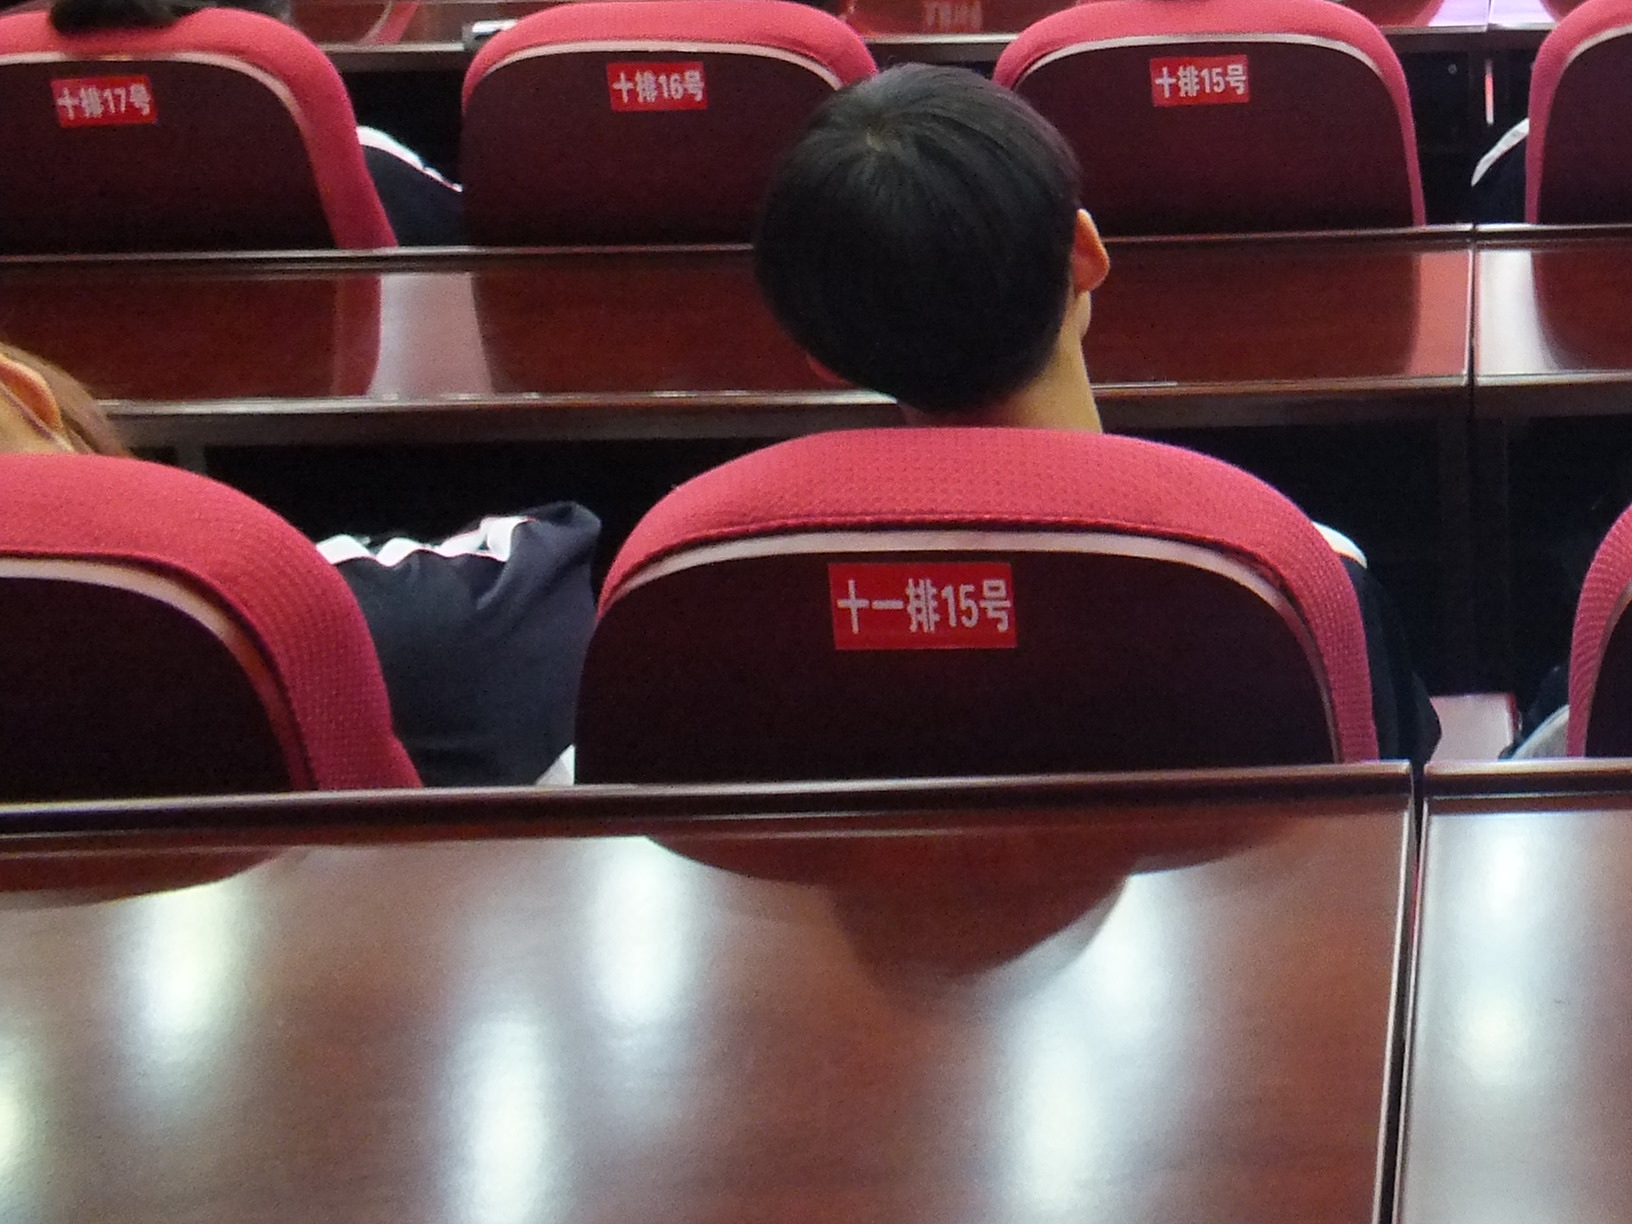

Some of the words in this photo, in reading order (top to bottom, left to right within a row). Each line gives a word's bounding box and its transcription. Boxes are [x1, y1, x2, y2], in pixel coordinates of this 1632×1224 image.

[612, 69, 705, 105] 十排16号
[1154, 63, 1248, 99] 十排15号
[57, 82, 152, 121] 十排17号
[836, 578, 1012, 636] 十一排15号
